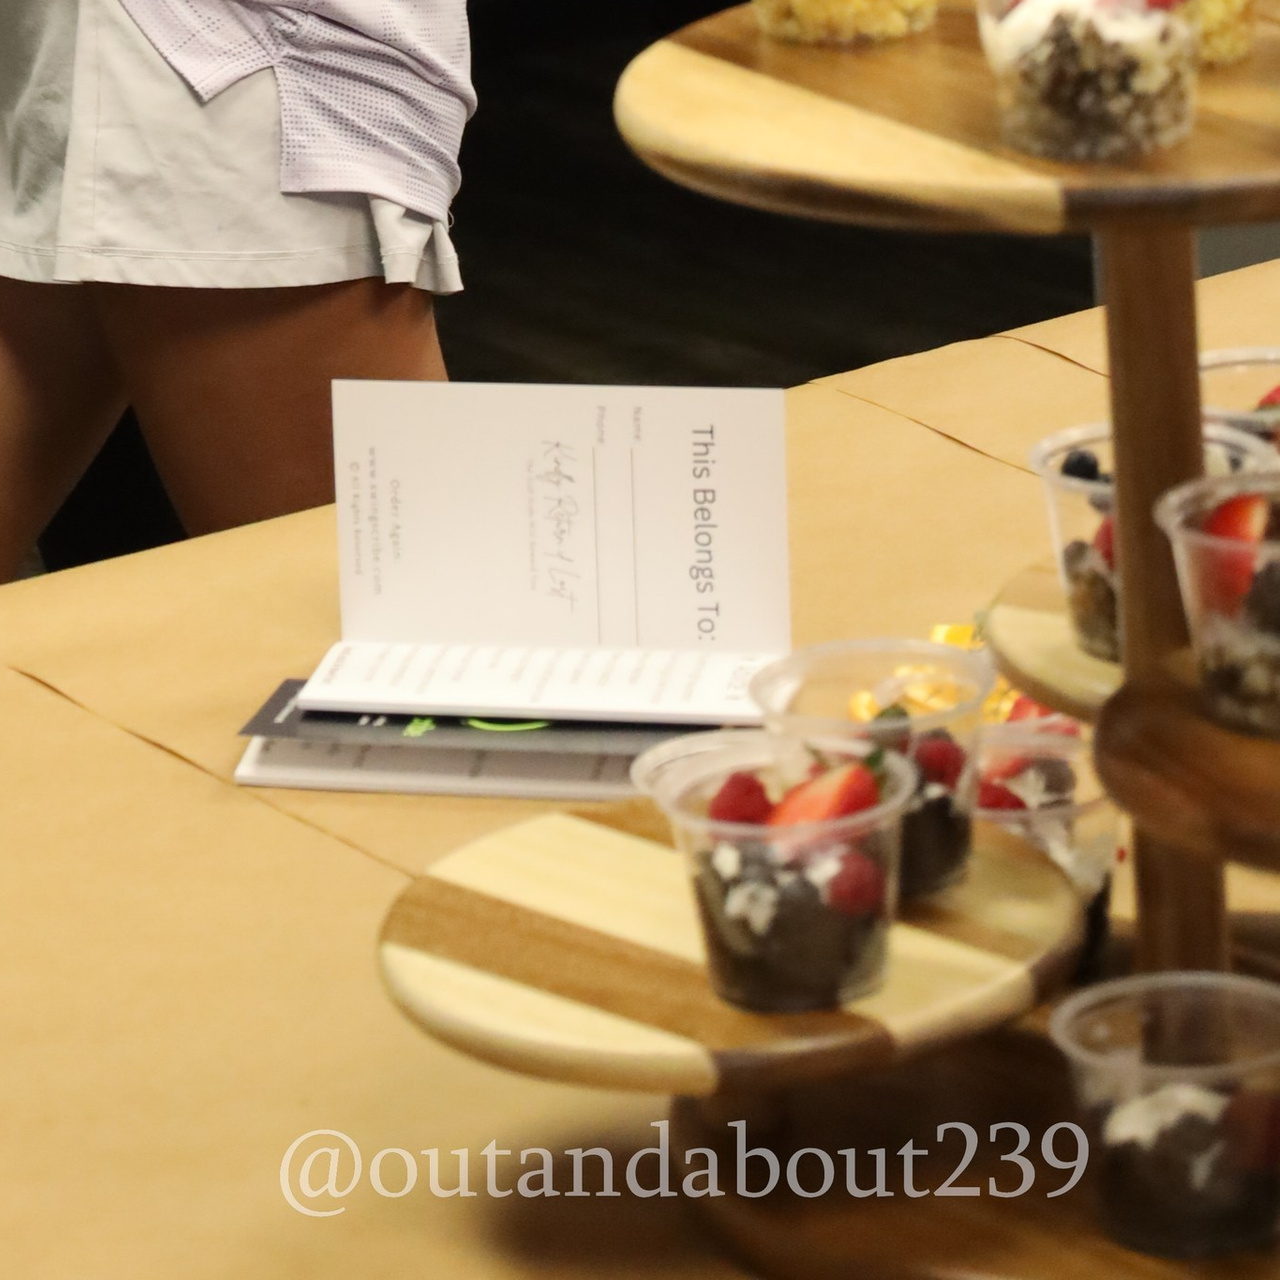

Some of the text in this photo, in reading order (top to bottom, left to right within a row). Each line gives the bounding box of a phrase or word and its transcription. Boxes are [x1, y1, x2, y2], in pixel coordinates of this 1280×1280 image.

[389, 478, 402, 518] Order
[689, 425, 720, 641] This Belongs To:
